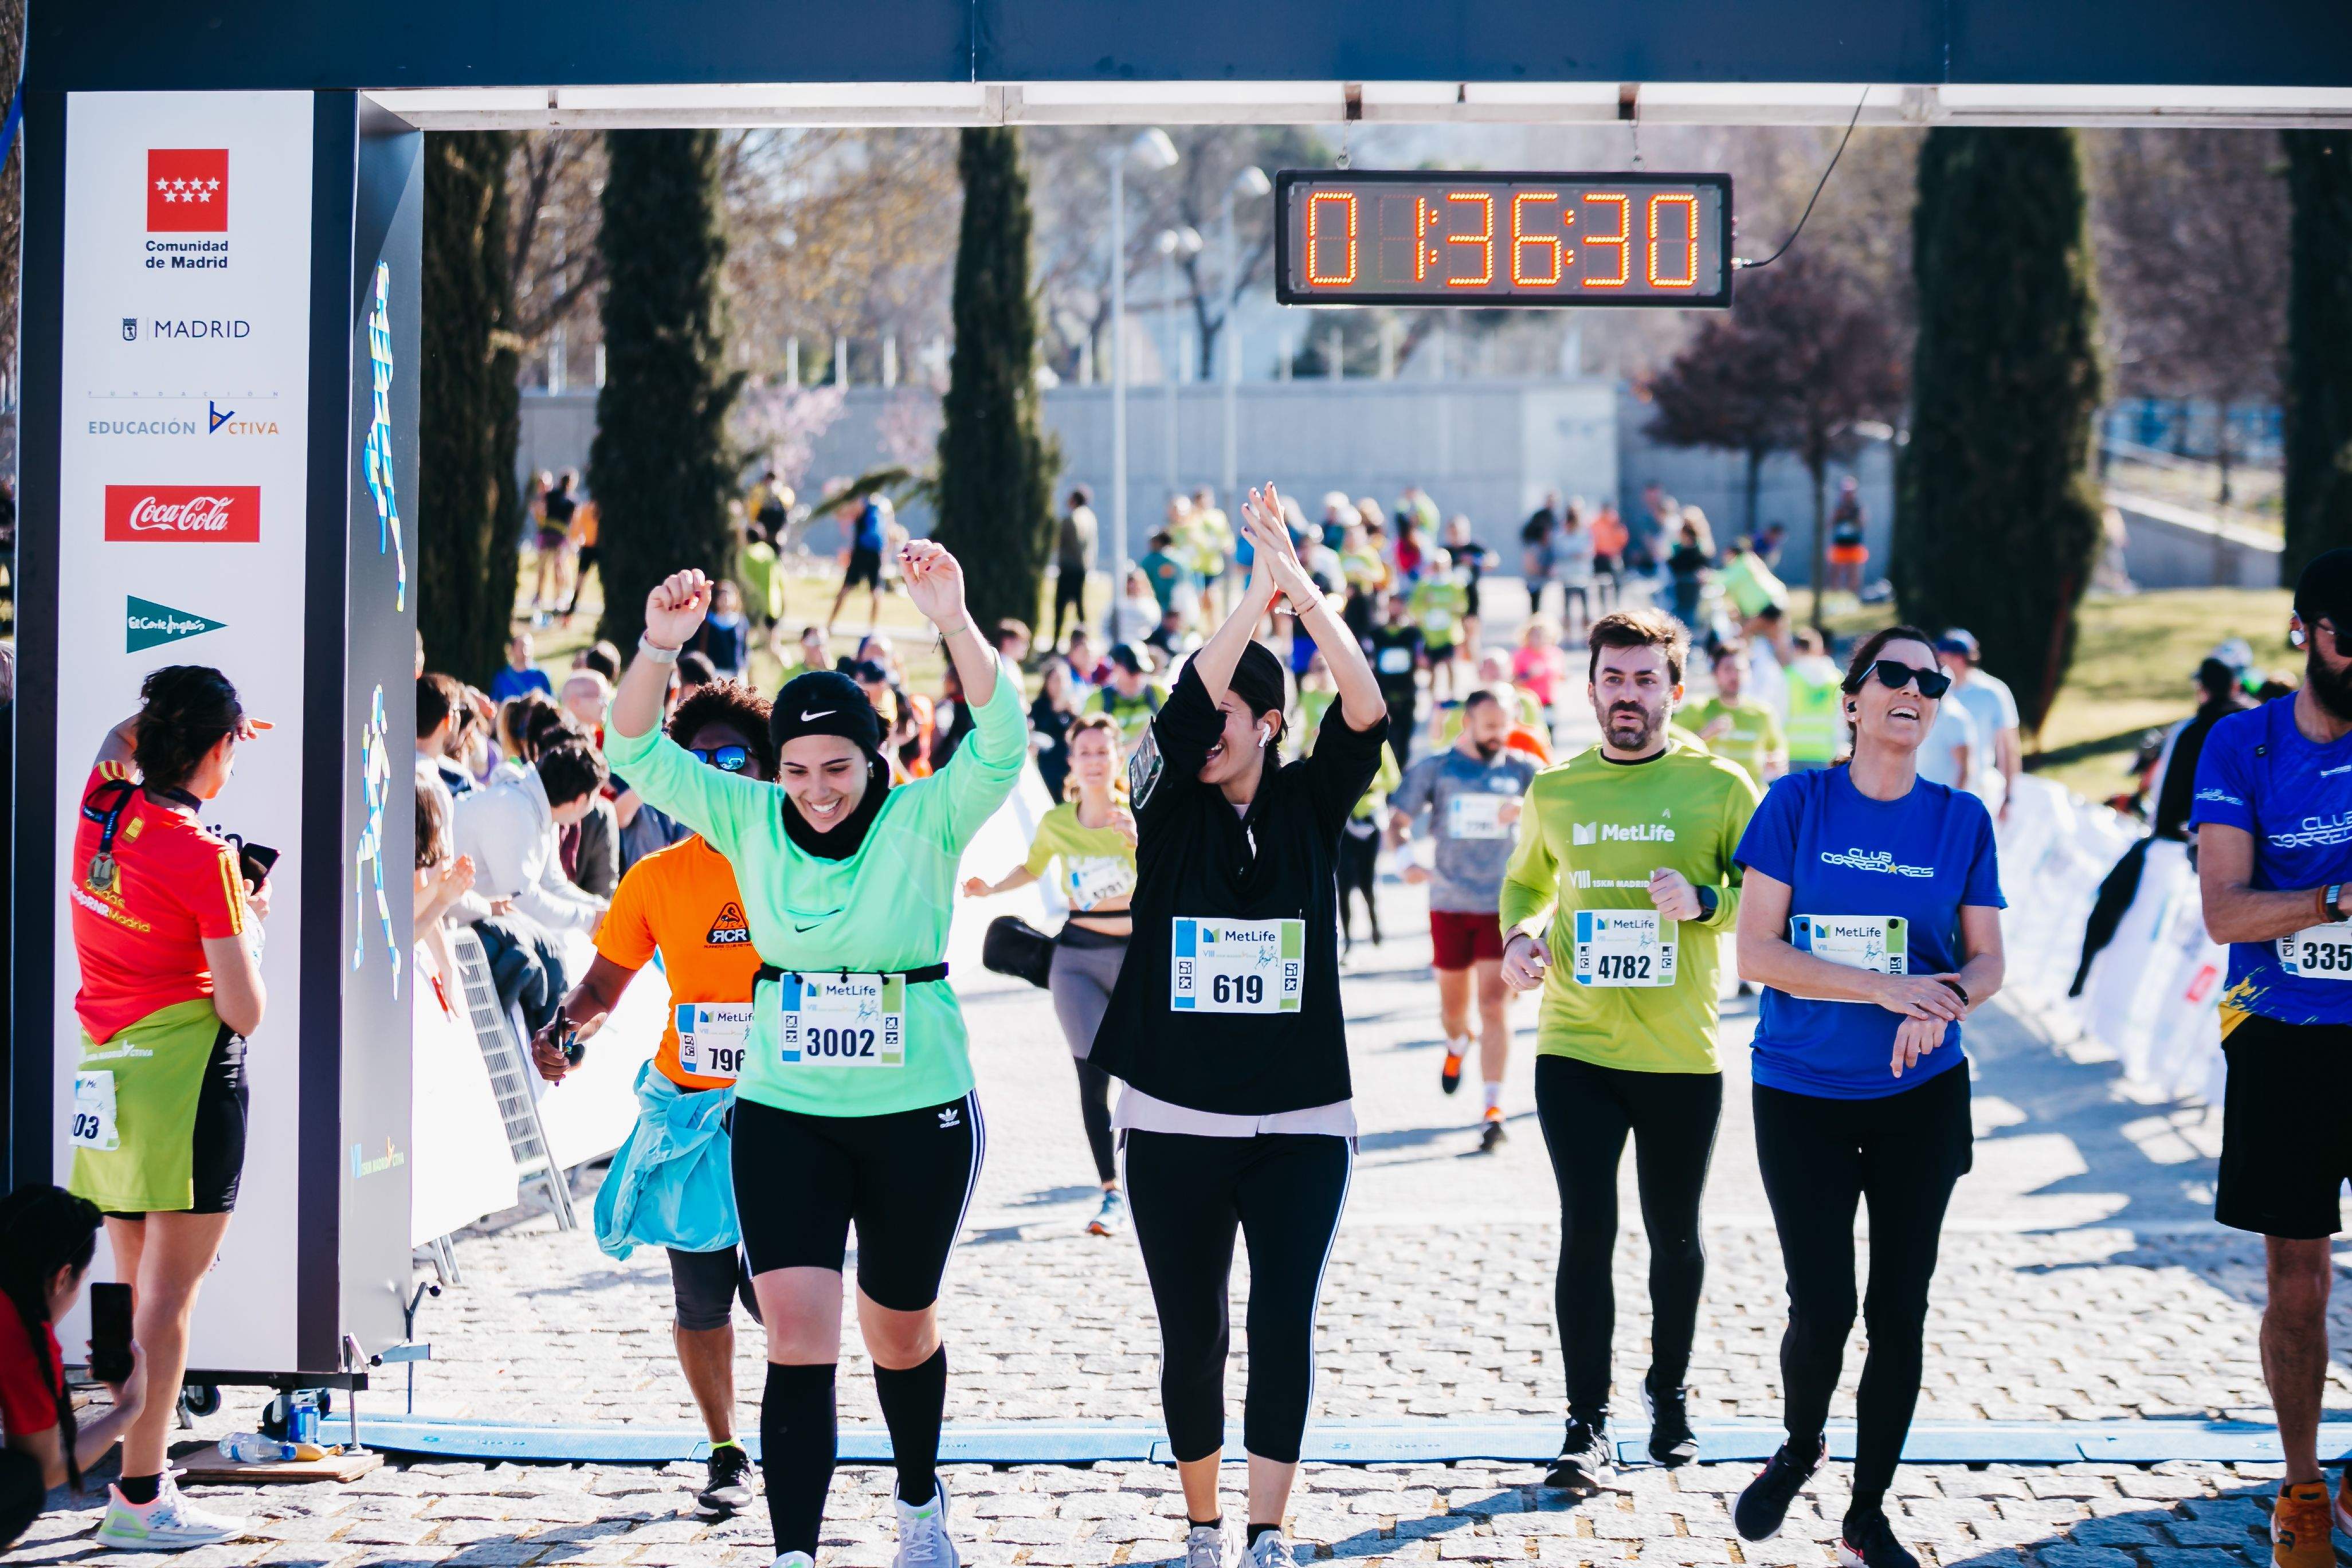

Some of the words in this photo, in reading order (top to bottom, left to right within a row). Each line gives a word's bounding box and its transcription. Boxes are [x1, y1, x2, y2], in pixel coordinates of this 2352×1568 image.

[146, 240, 228, 252] Comunidad
[1306, 192, 1699, 287] 01:36:30
[146, 256, 165, 268] de
[171, 256, 228, 268] Madrid
[155, 320, 250, 338] MADRID
[89, 418, 195, 434] EDUCACIÓN
[130, 496, 234, 531] Coca-Cola
[141, 617, 167, 629] Corte
[167, 615, 205, 634] Inglés
[1601, 824, 1675, 841] MetLife
[1848, 848, 1892, 863] CLUB
[1569, 870, 1591, 888] VIII
[1592, 880, 1614, 888] 15KM
[1614, 919, 1655, 929] MetLife
[1835, 927, 1881, 938] MetLife
[1225, 931, 1276, 942] MetLife
[2303, 942, 2352, 971] 335
[1598, 956, 1651, 979] 4782
[826, 985, 876, 996] MetLife
[1213, 975, 1263, 1003] 619
[807, 1028, 875, 1056] 3002
[72, 1113, 100, 1139] 03
